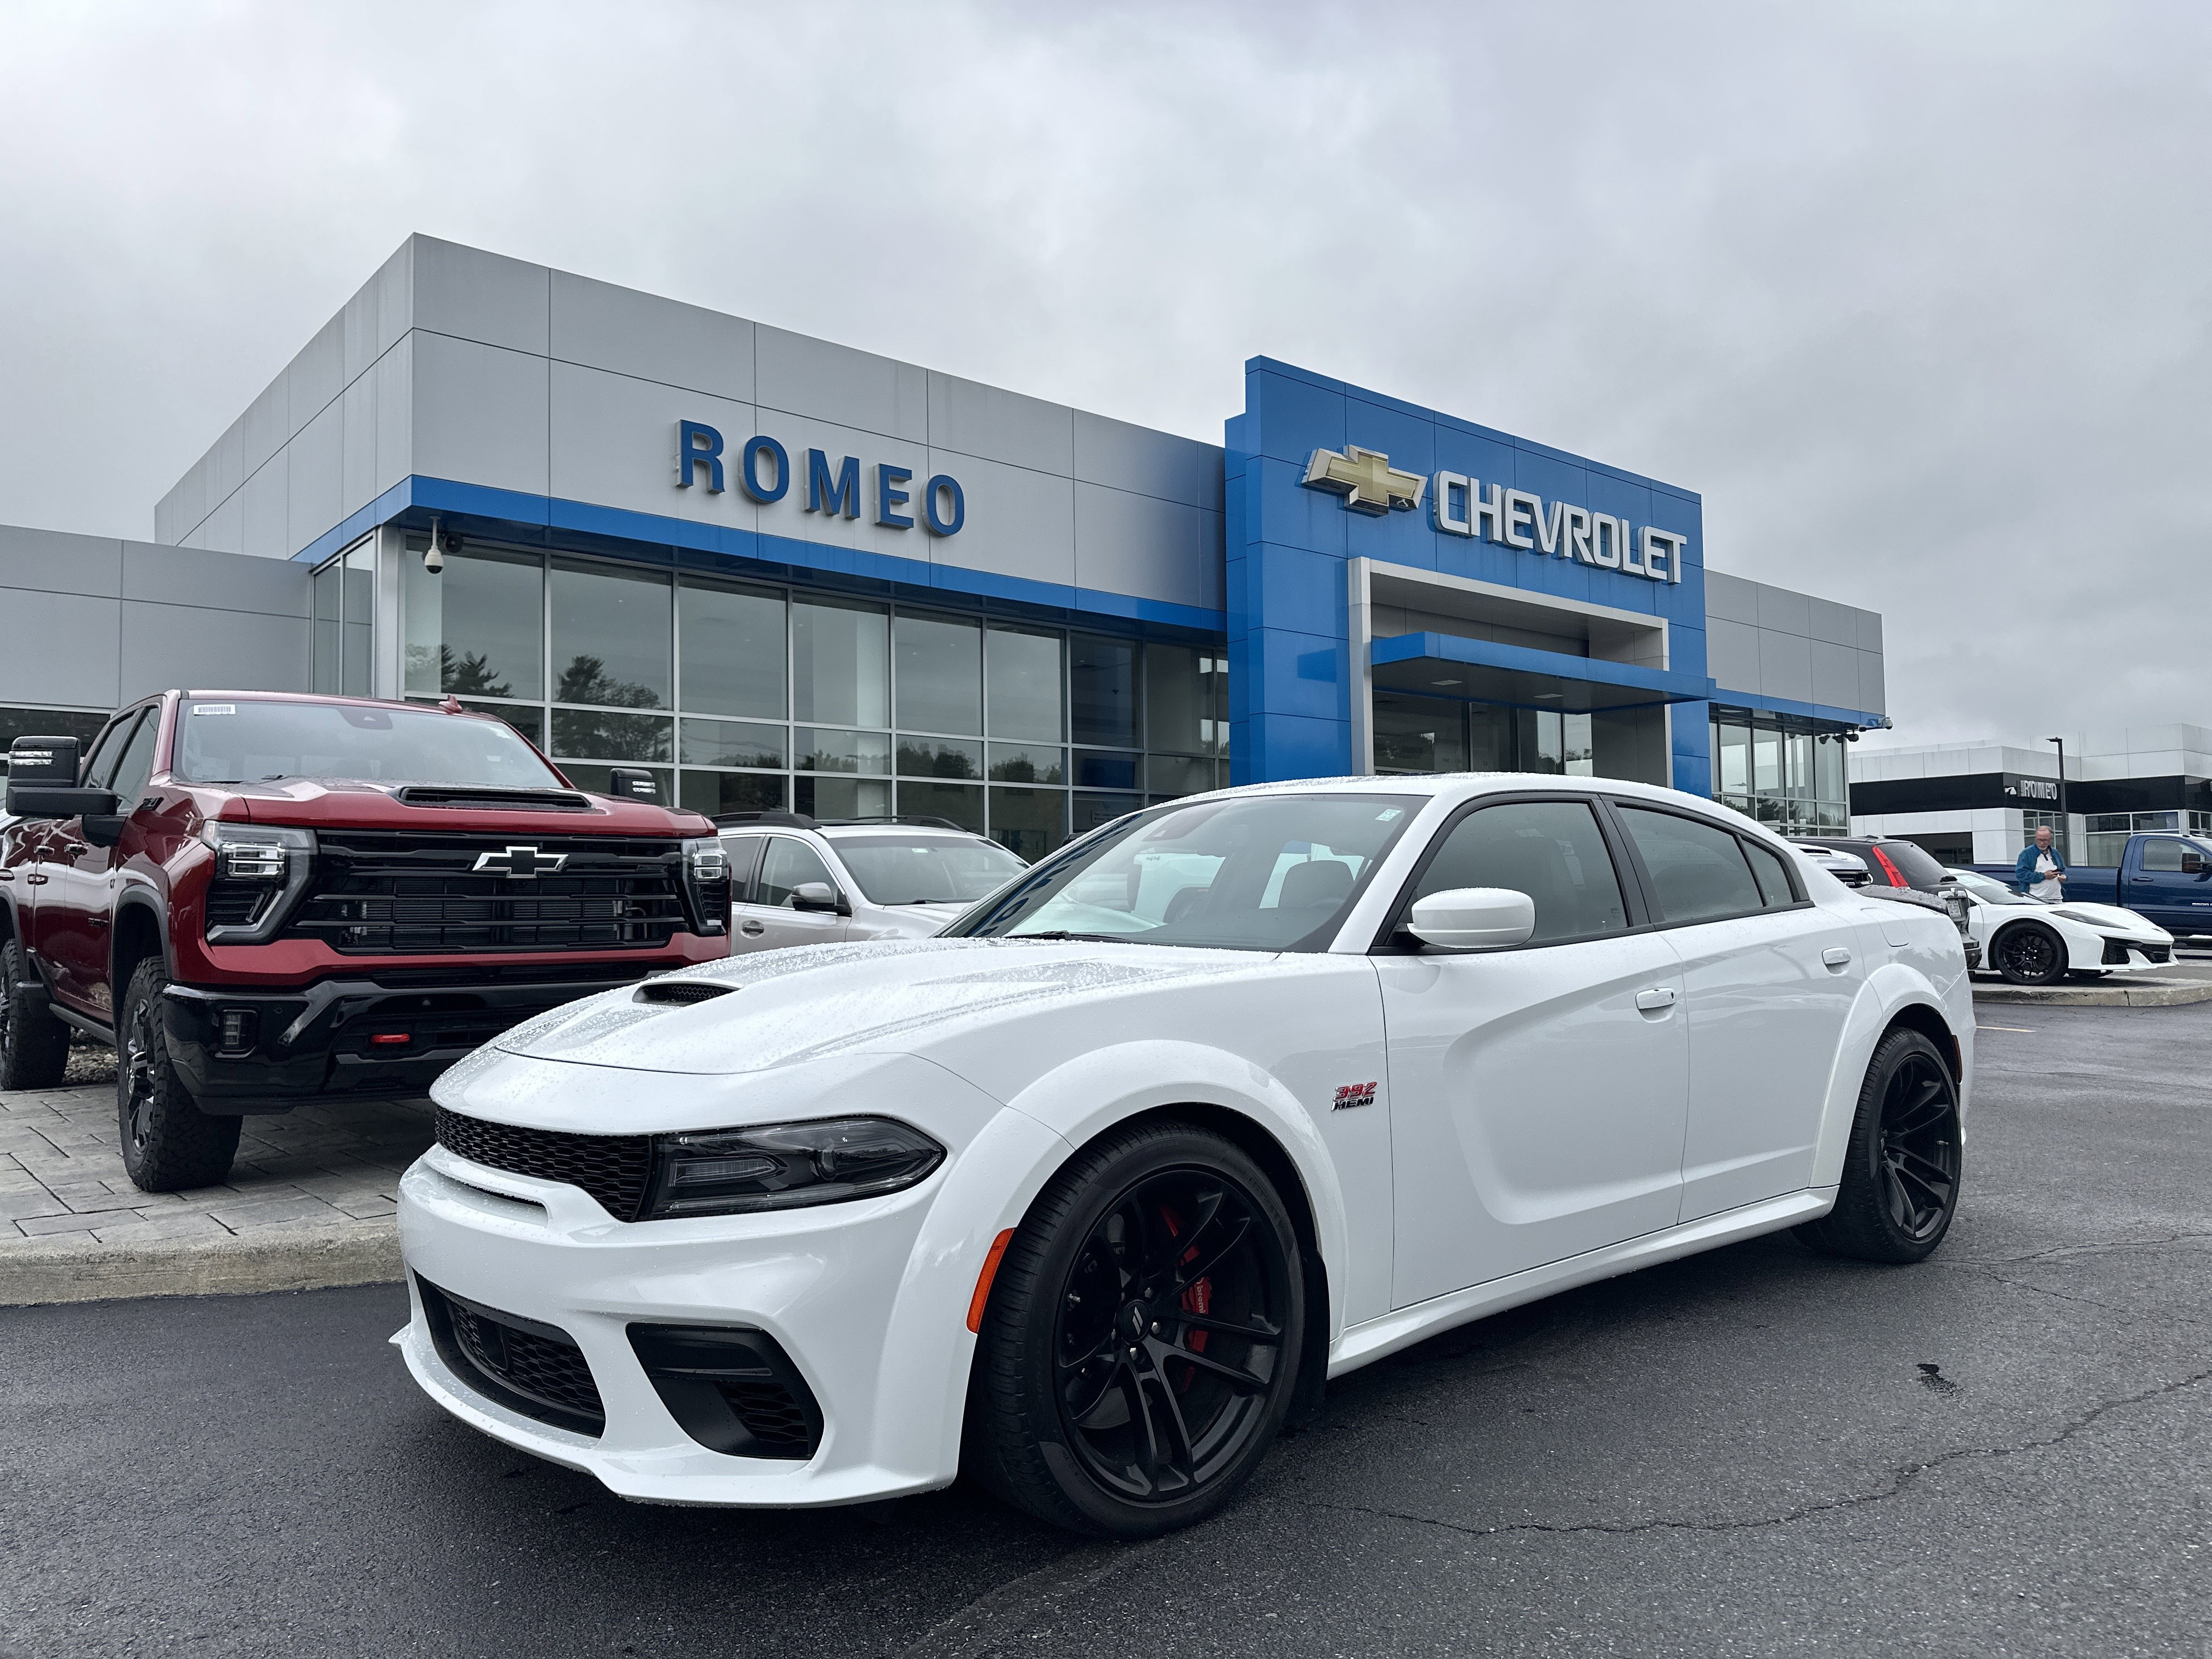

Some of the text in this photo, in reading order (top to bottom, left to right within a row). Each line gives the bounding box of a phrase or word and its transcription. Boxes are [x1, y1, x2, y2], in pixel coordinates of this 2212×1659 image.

[676, 419, 964, 537] ROMEO
[1433, 470, 1687, 585] CHEVROLET
[2021, 780, 2057, 799] ROMEO
[1333, 1082, 1377, 1101] 392
[1331, 1097, 1374, 1111] HEMI
